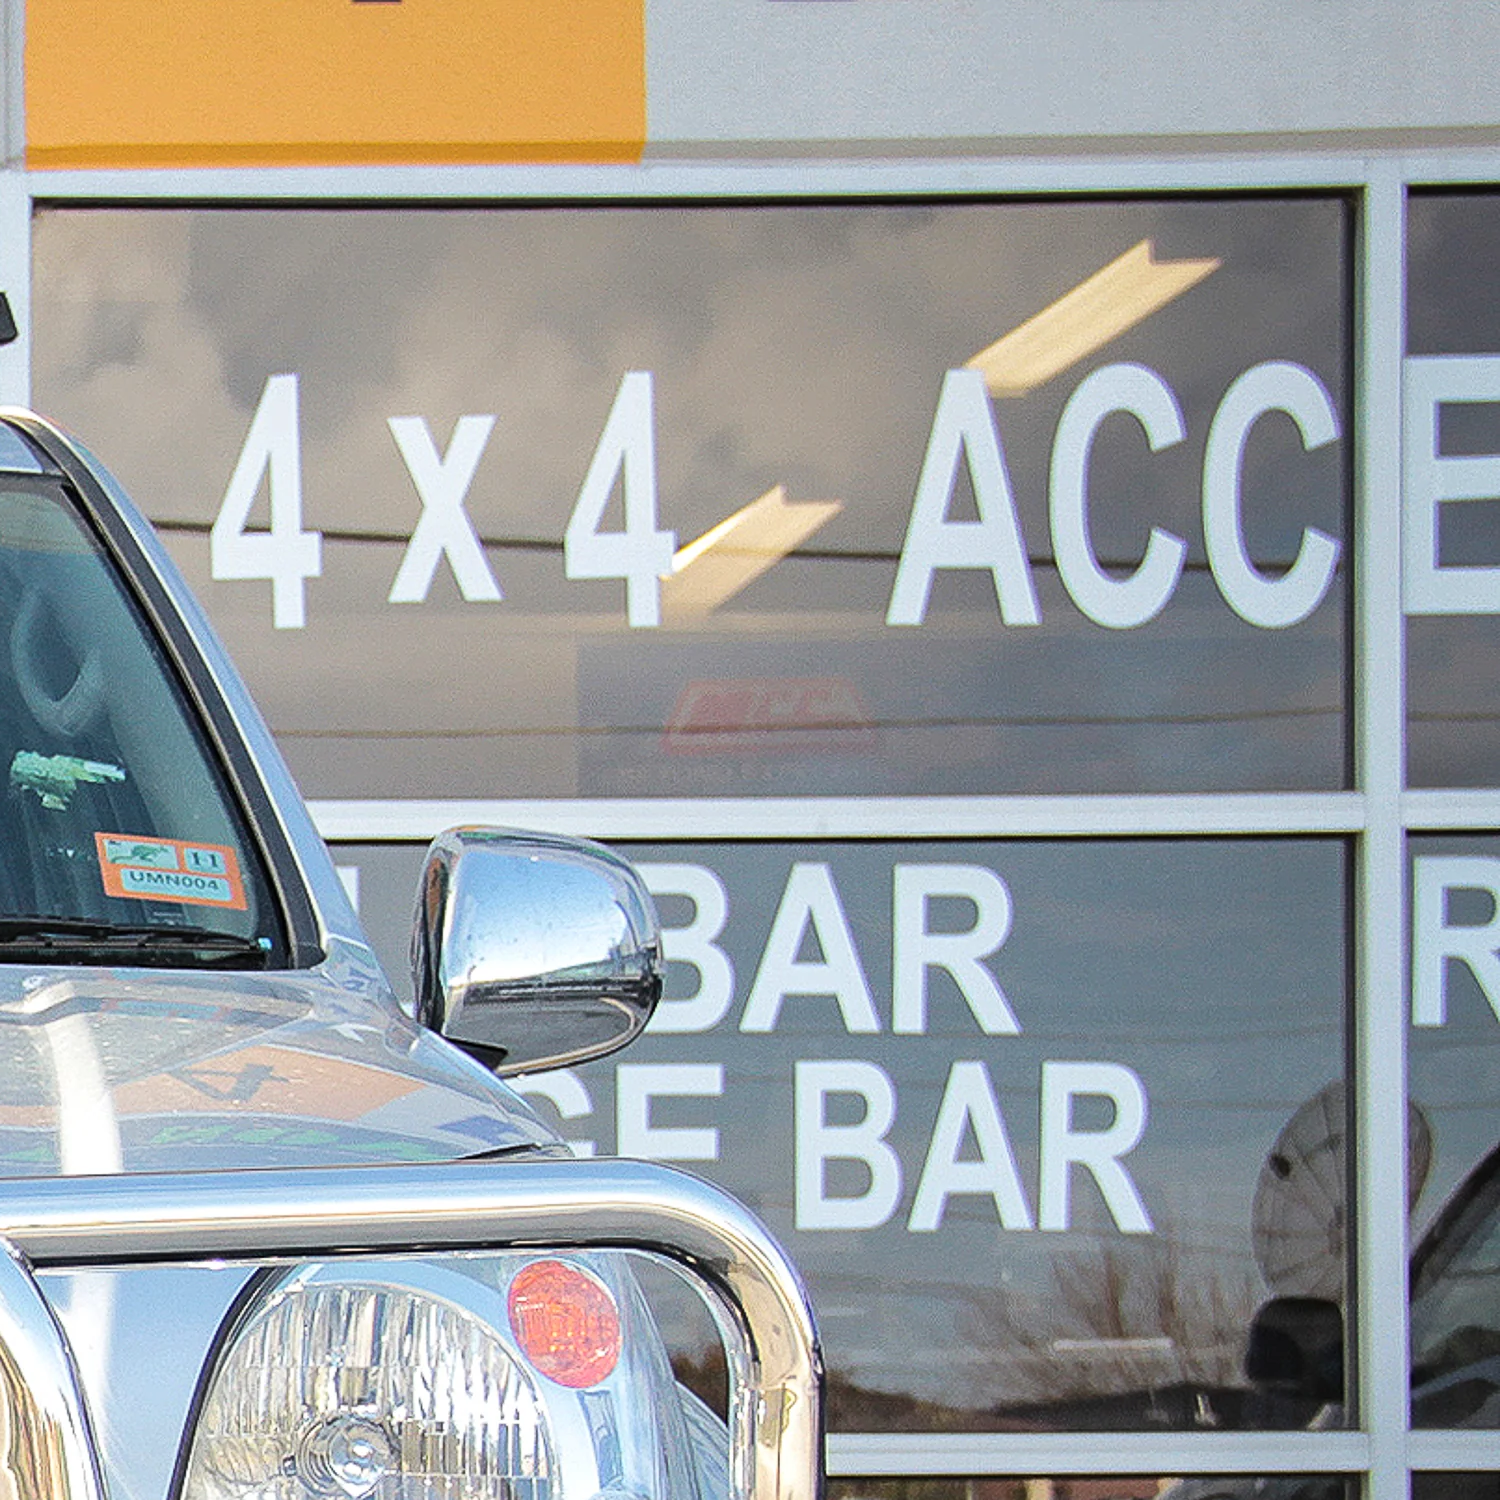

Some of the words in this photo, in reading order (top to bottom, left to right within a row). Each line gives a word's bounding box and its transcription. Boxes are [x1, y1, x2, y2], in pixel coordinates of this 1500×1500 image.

[130, 870, 219, 890] UMN004
[636, 862, 1021, 1035] BAR
[793, 1061, 1155, 1233] BAR
